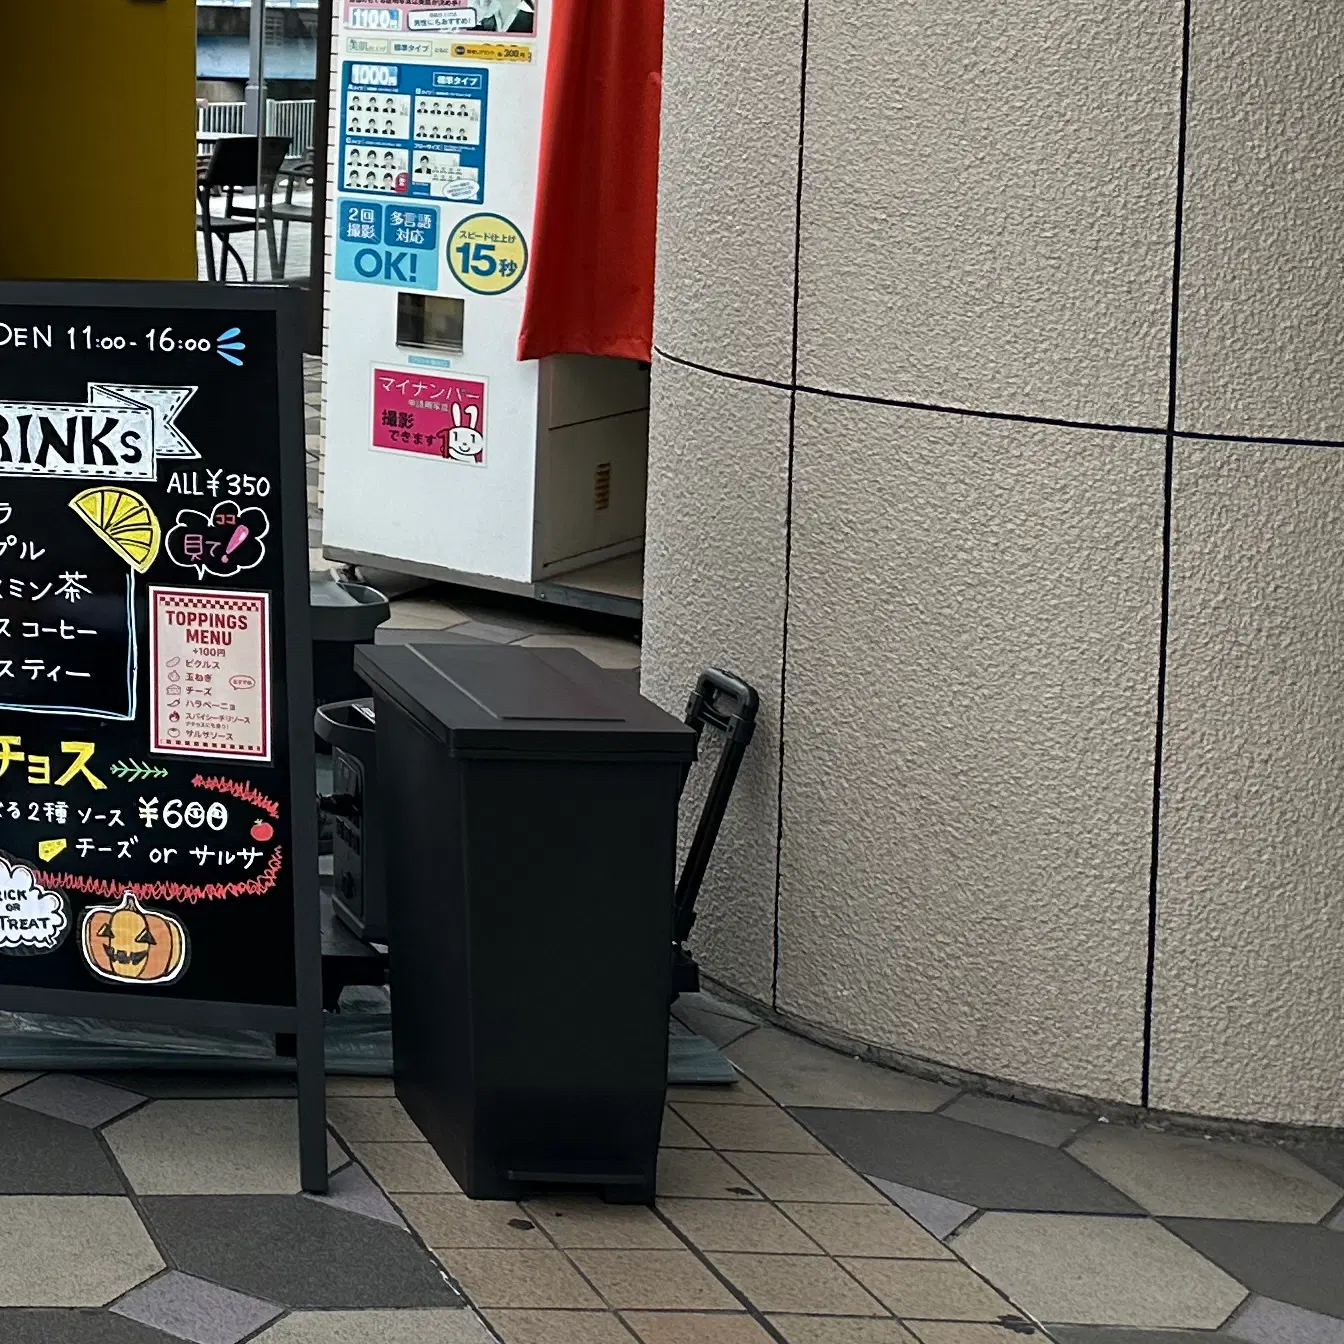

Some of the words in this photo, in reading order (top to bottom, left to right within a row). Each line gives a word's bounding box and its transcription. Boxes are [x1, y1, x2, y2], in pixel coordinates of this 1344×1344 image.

[348, 208, 375, 223] 2回
[390, 211, 432, 230] 多言語
[347, 224, 376, 239] 撮影
[395, 229, 425, 244] 対応
[459, 230, 516, 244] スピード仕上げ
[354, 248, 418, 283] OK!
[378, 377, 480, 401] マイナンバー
[382, 409, 414, 429] 撮影
[389, 429, 436, 446] できます
[165, 610, 248, 630] TOPPINGS
[186, 629, 232, 646] MENU
[193, 647, 226, 657] +100円
[186, 687, 212, 696] チーズ
[186, 730, 234, 741] サルサソース
[138, 796, 228, 831] ¥600
[75, 837, 139, 859] チーズ
[149, 846, 178, 864] or
[190, 846, 263, 869] サルサ
